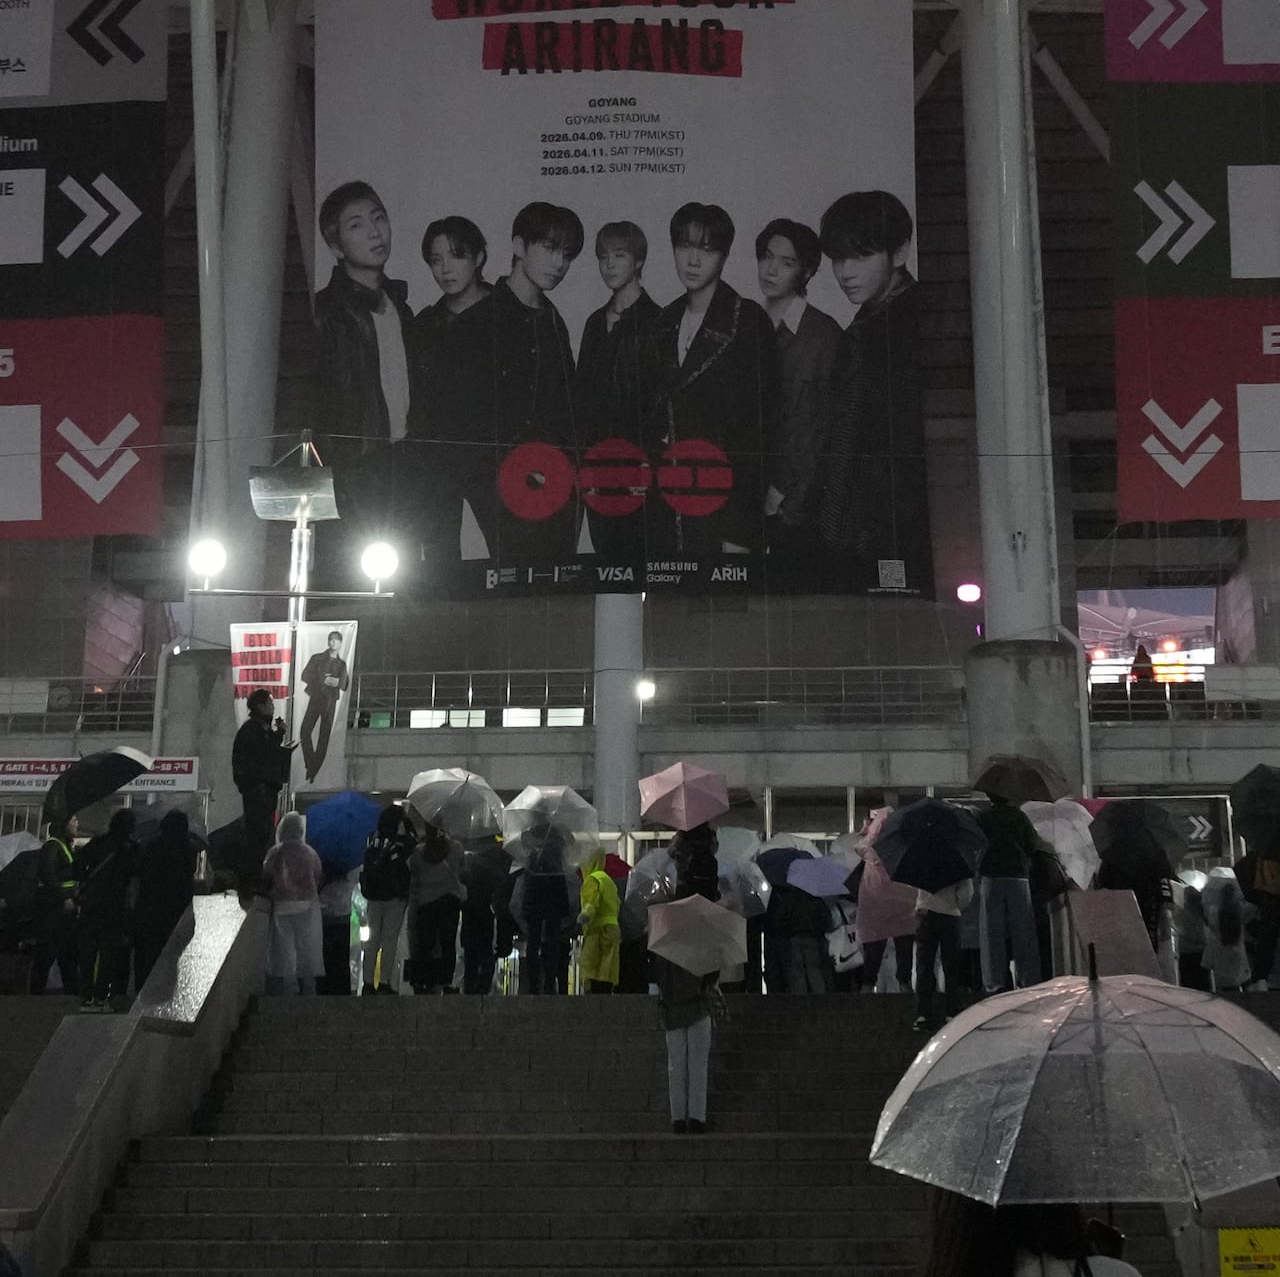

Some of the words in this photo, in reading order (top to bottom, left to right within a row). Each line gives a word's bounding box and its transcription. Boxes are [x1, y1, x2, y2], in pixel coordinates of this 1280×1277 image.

[500, 17, 725, 76] ARIRANG
[589, 97, 637, 108] GOYANG
[565, 114, 610, 125] GOYANG
[613, 113, 660, 124] STADIUM
[540, 131, 606, 143] 2026.04.09.
[609, 130, 631, 140] THU
[634, 130, 685, 141] 7PM(KST)
[542, 147, 608, 159] 2026.04.11.
[610, 146, 630, 157] SAT
[633, 146, 684, 158] 7PM(KST)
[540, 164, 606, 176] 2026.04.12.
[608, 163, 631, 173] SUN
[634, 162, 686, 174] 7PM(KST)
[647, 562, 698, 572] SAMSUNG
[596, 567, 634, 581] VISA
[647, 574, 681, 585] Galaxy
[711, 567, 747, 581] ARIH
[249, 633, 272, 647] BTS
[246, 668, 276, 682] TOUR
[6, 763, 27, 772] GATE
[135, 779, 177, 787] ENTRANCE
